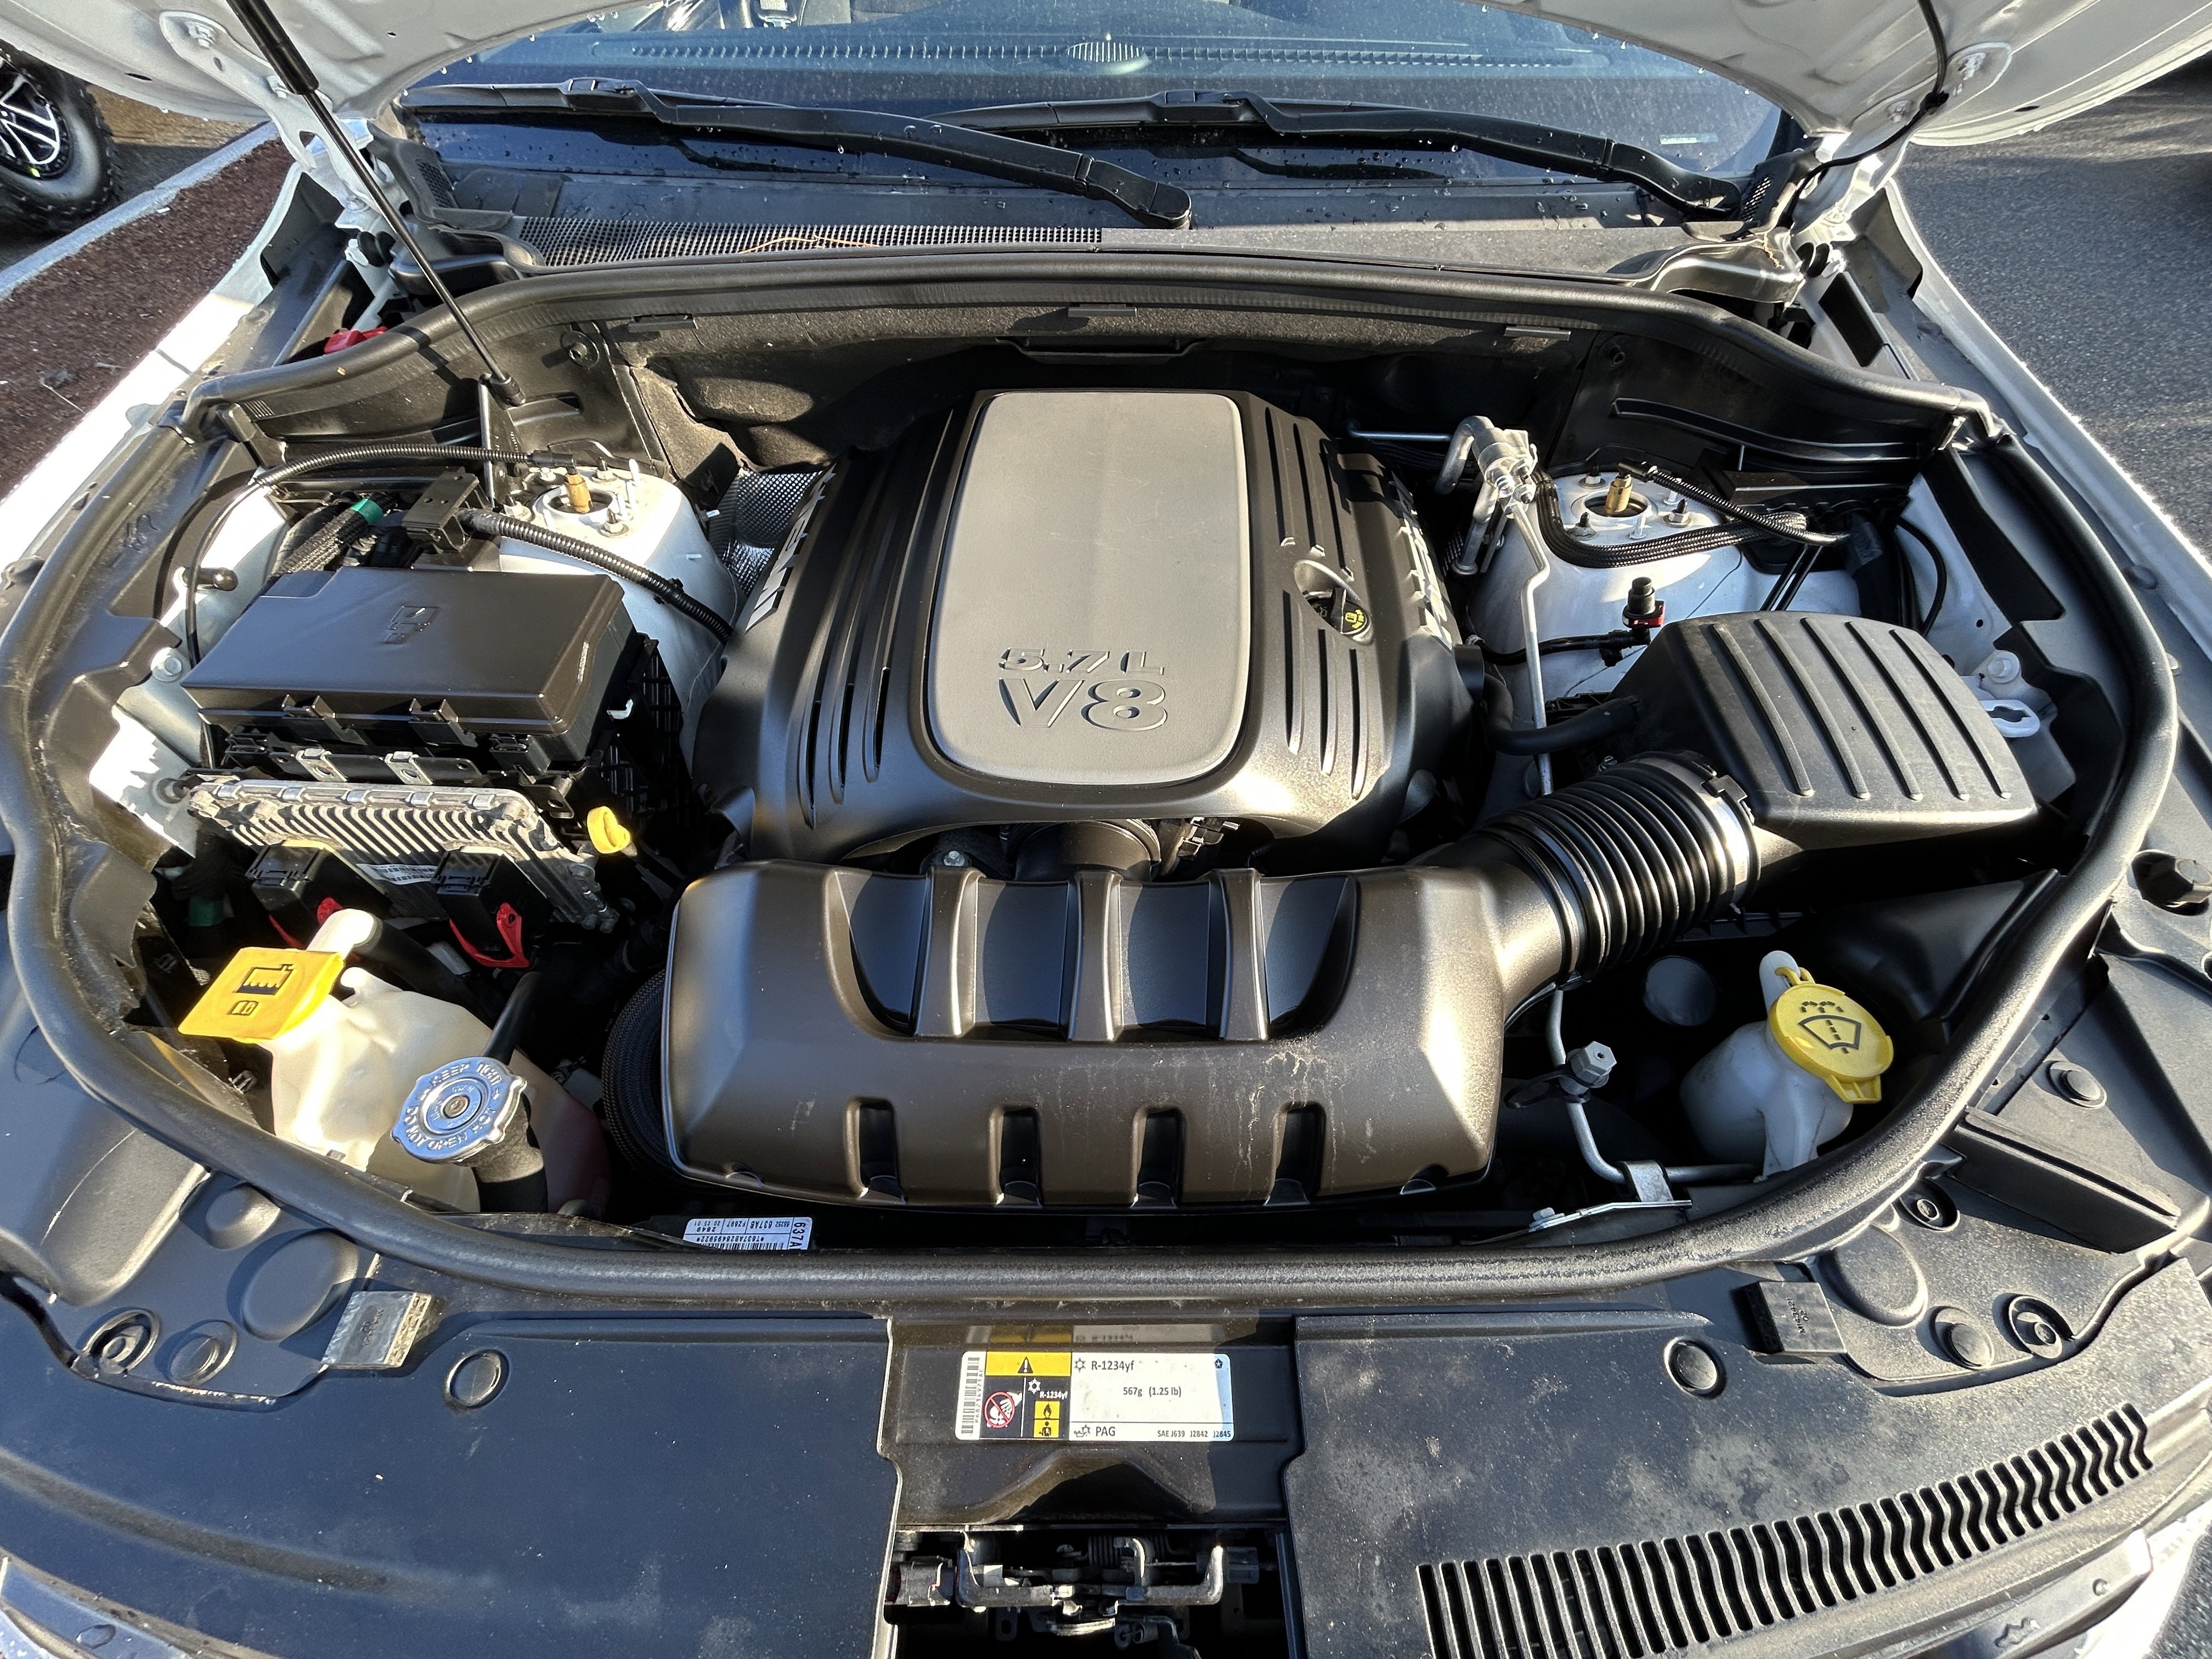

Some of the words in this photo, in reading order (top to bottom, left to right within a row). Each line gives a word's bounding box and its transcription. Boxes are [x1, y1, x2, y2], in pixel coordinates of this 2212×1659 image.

[998, 678, 1169, 732] V8
[430, 1063, 470, 1087] KEEP
[403, 1105, 419, 1126] DO
[471, 1105, 496, 1134] HOT
[405, 1127, 429, 1147] NOT
[427, 1132, 469, 1151] OPEN
[750, 1221, 772, 1229] 637AB
[1091, 1361, 1135, 1372] R-1234yf
[1039, 1391, 1068, 1400] R-1234yf
[1122, 1387, 1143, 1398] 567g
[1149, 1386, 1169, 1398] (1.25
[1170, 1386, 1182, 1398] lb)
[1096, 1426, 1116, 1437] PAG
